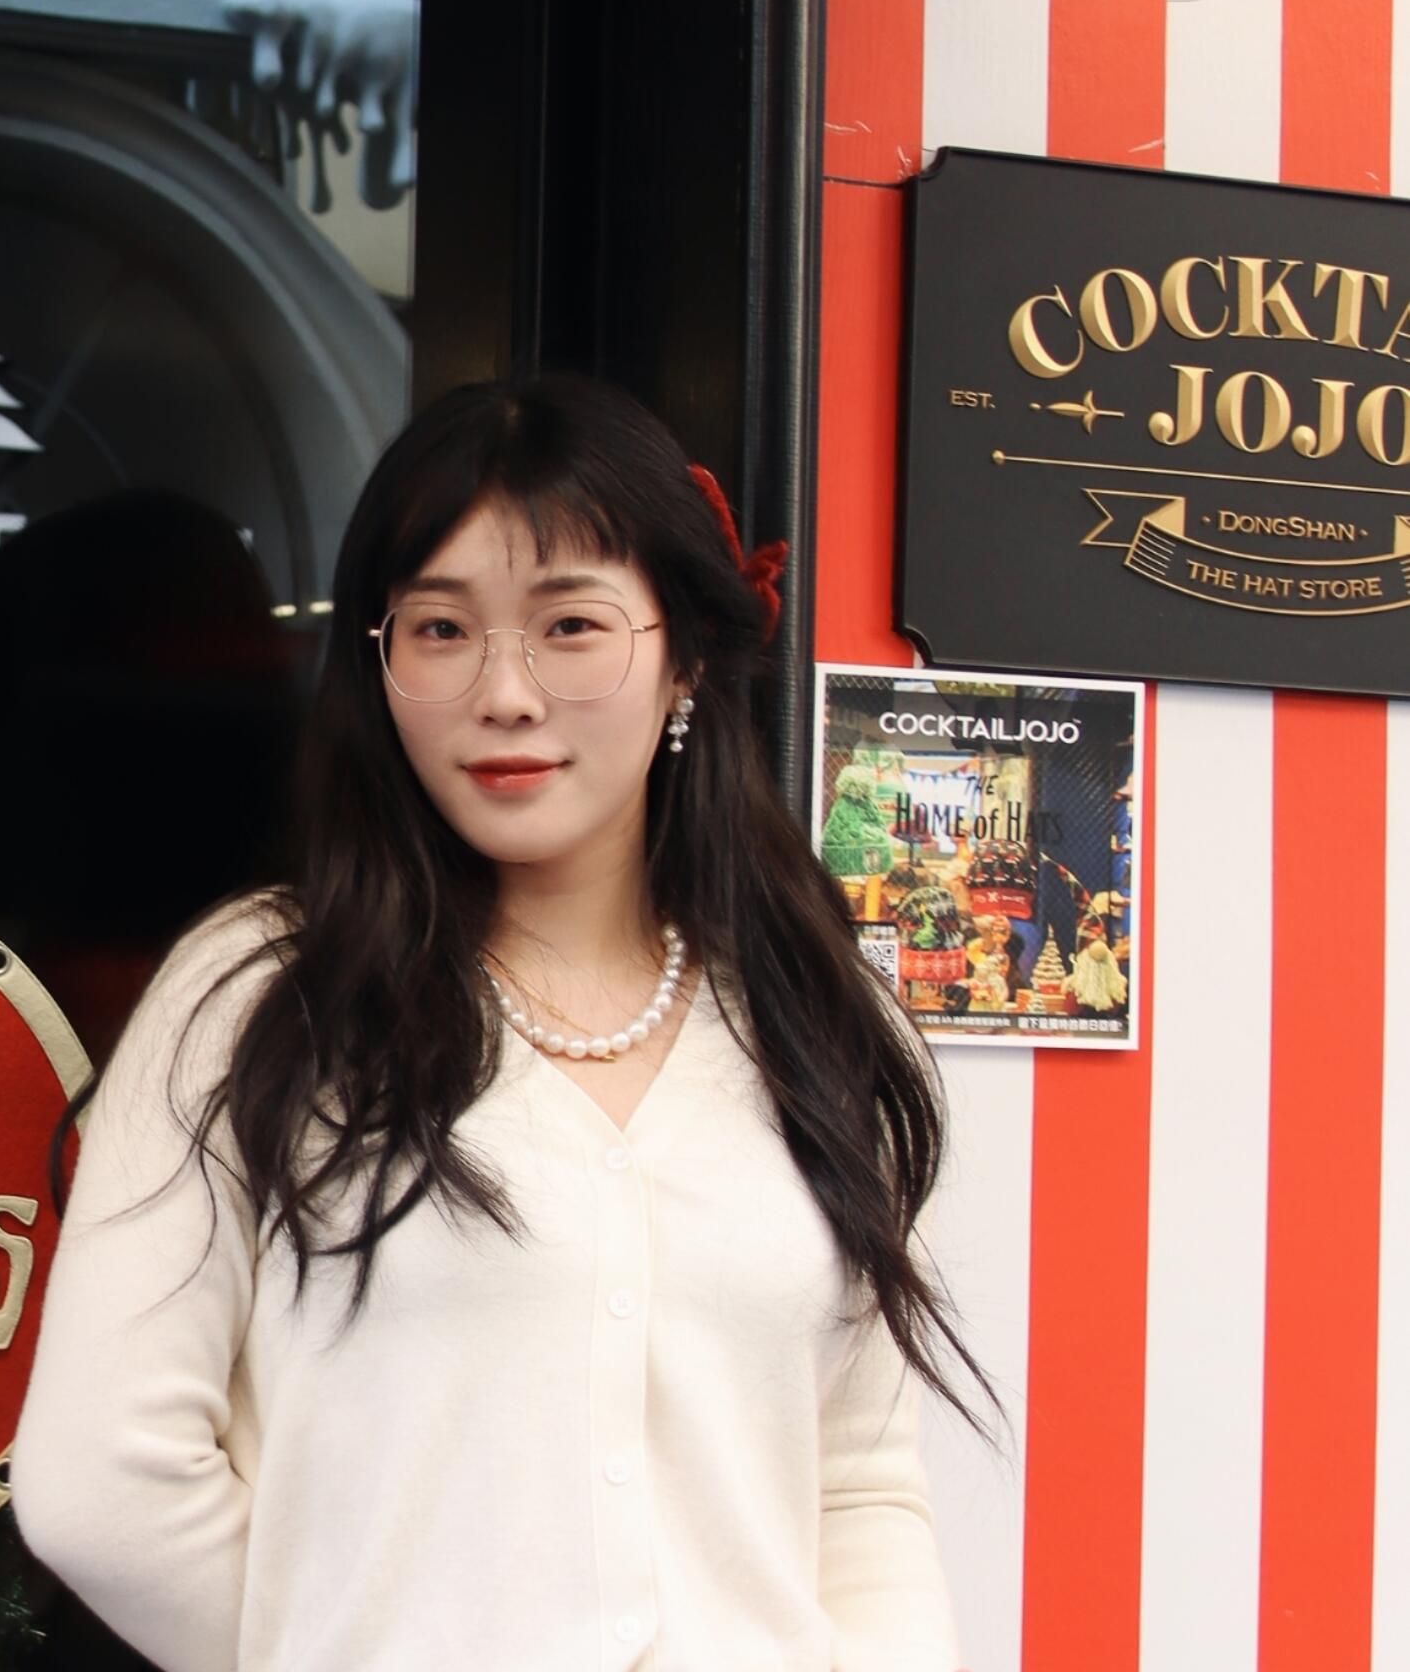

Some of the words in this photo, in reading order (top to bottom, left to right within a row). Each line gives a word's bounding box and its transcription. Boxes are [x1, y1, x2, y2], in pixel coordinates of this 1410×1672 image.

[950, 389, 995, 409] EST.
[1186, 559, 1239, 590] THE
[1242, 573, 1294, 596] HAT
[1299, 577, 1384, 600] STORE
[896, 791, 966, 839] HOME
[974, 808, 999, 840] of
